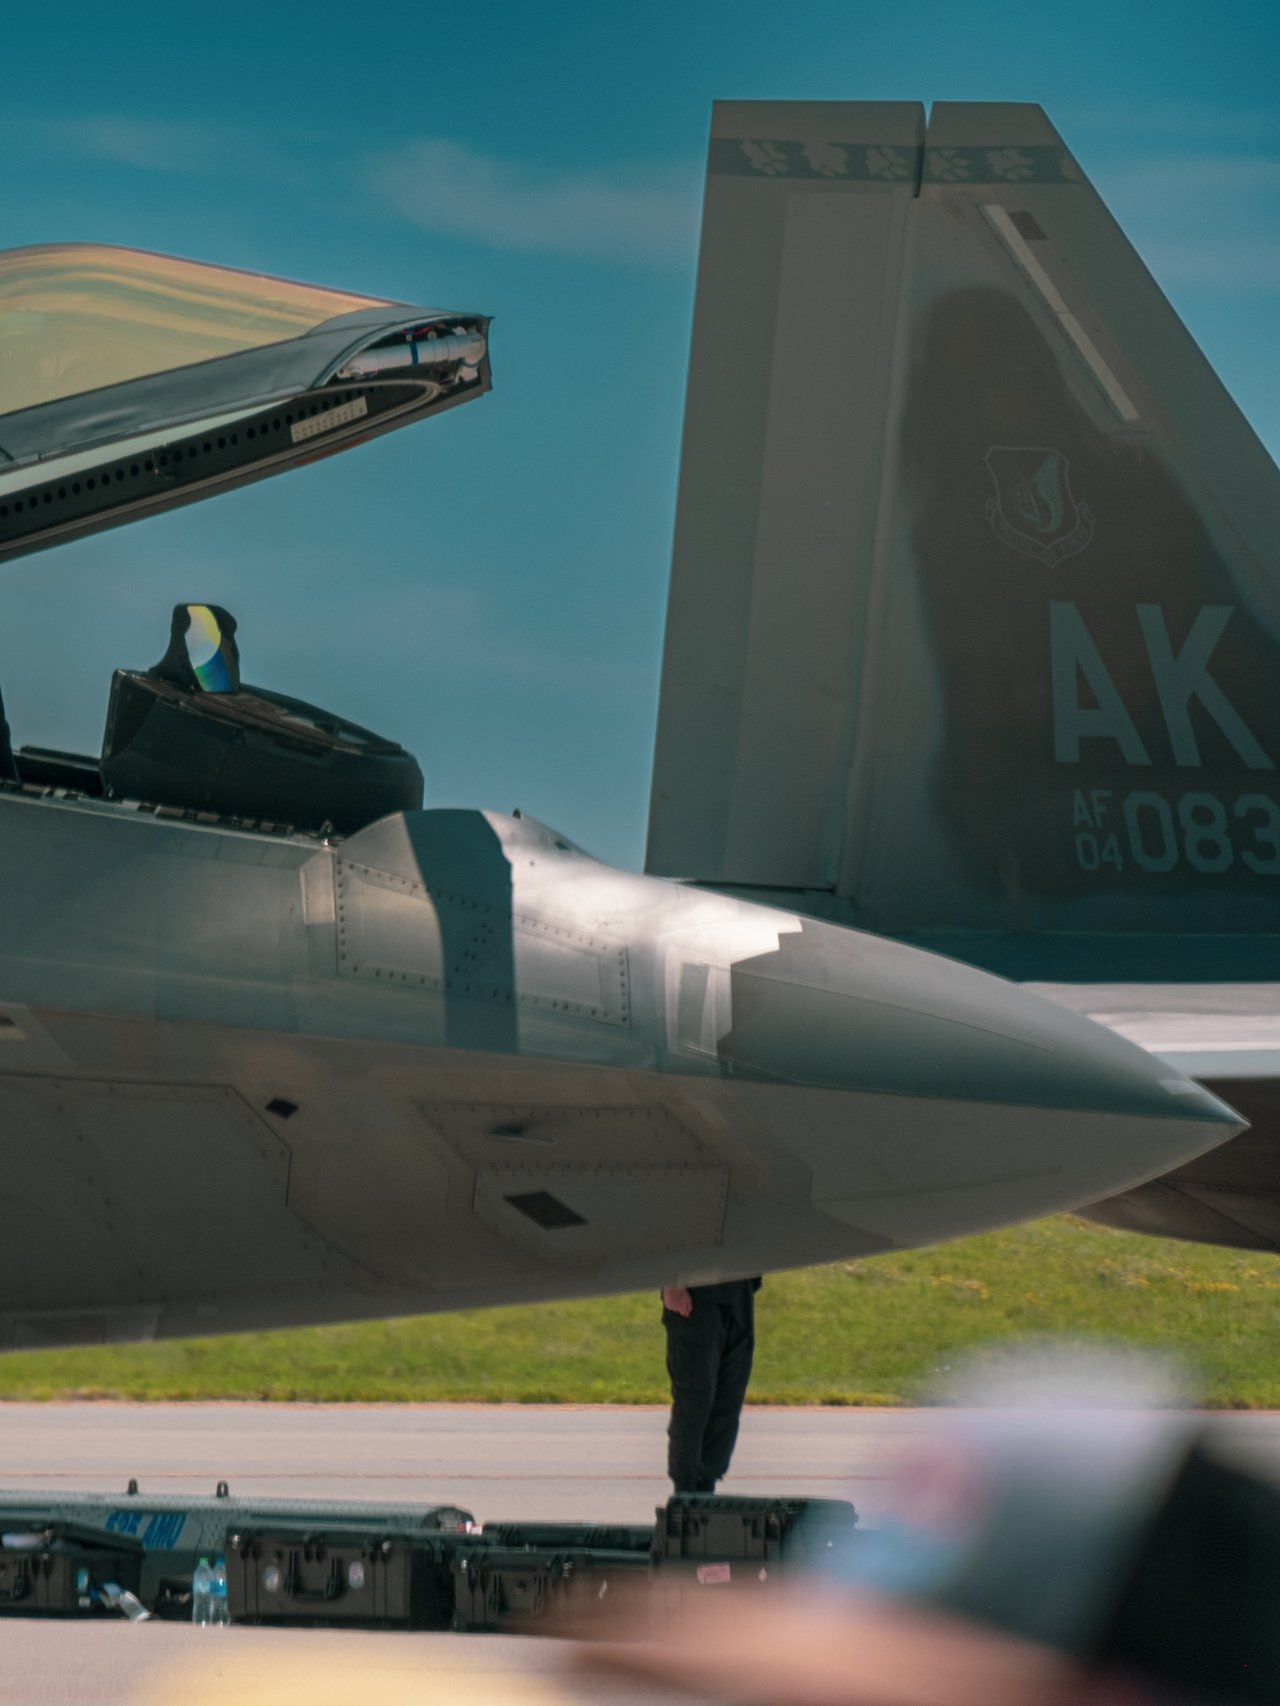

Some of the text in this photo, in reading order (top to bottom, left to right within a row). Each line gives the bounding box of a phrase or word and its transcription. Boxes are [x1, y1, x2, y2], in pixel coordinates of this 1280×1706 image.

[1049, 601, 1276, 769] AK
[1073, 789, 1112, 828] AF
[1075, 833, 1123, 871] 04
